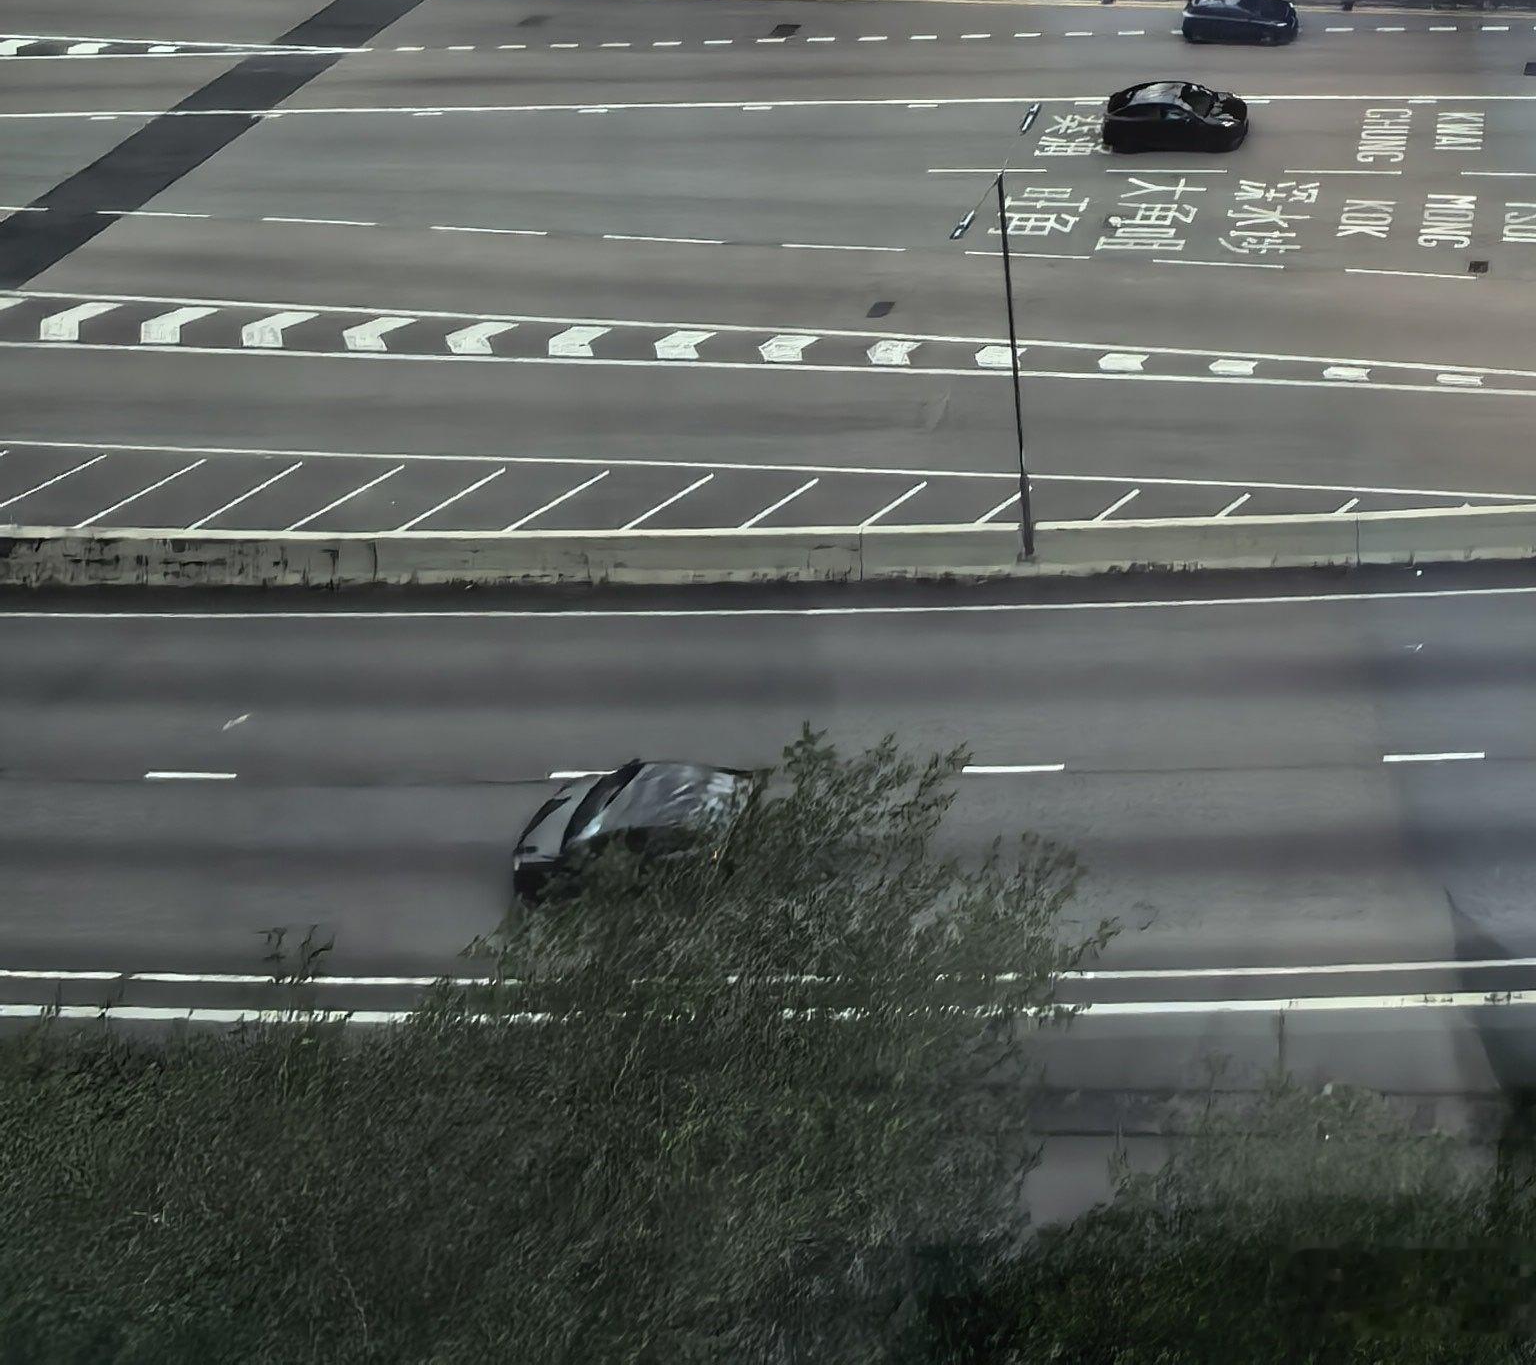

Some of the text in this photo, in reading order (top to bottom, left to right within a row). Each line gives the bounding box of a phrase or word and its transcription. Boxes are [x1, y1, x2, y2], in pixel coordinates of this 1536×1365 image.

[1356, 108, 1412, 162] CHUNG
[1433, 112, 1485, 150] KWAI
[987, 187, 1090, 237] 旺角
[1336, 199, 1398, 238] KOK
[1418, 193, 1478, 249] MONG
